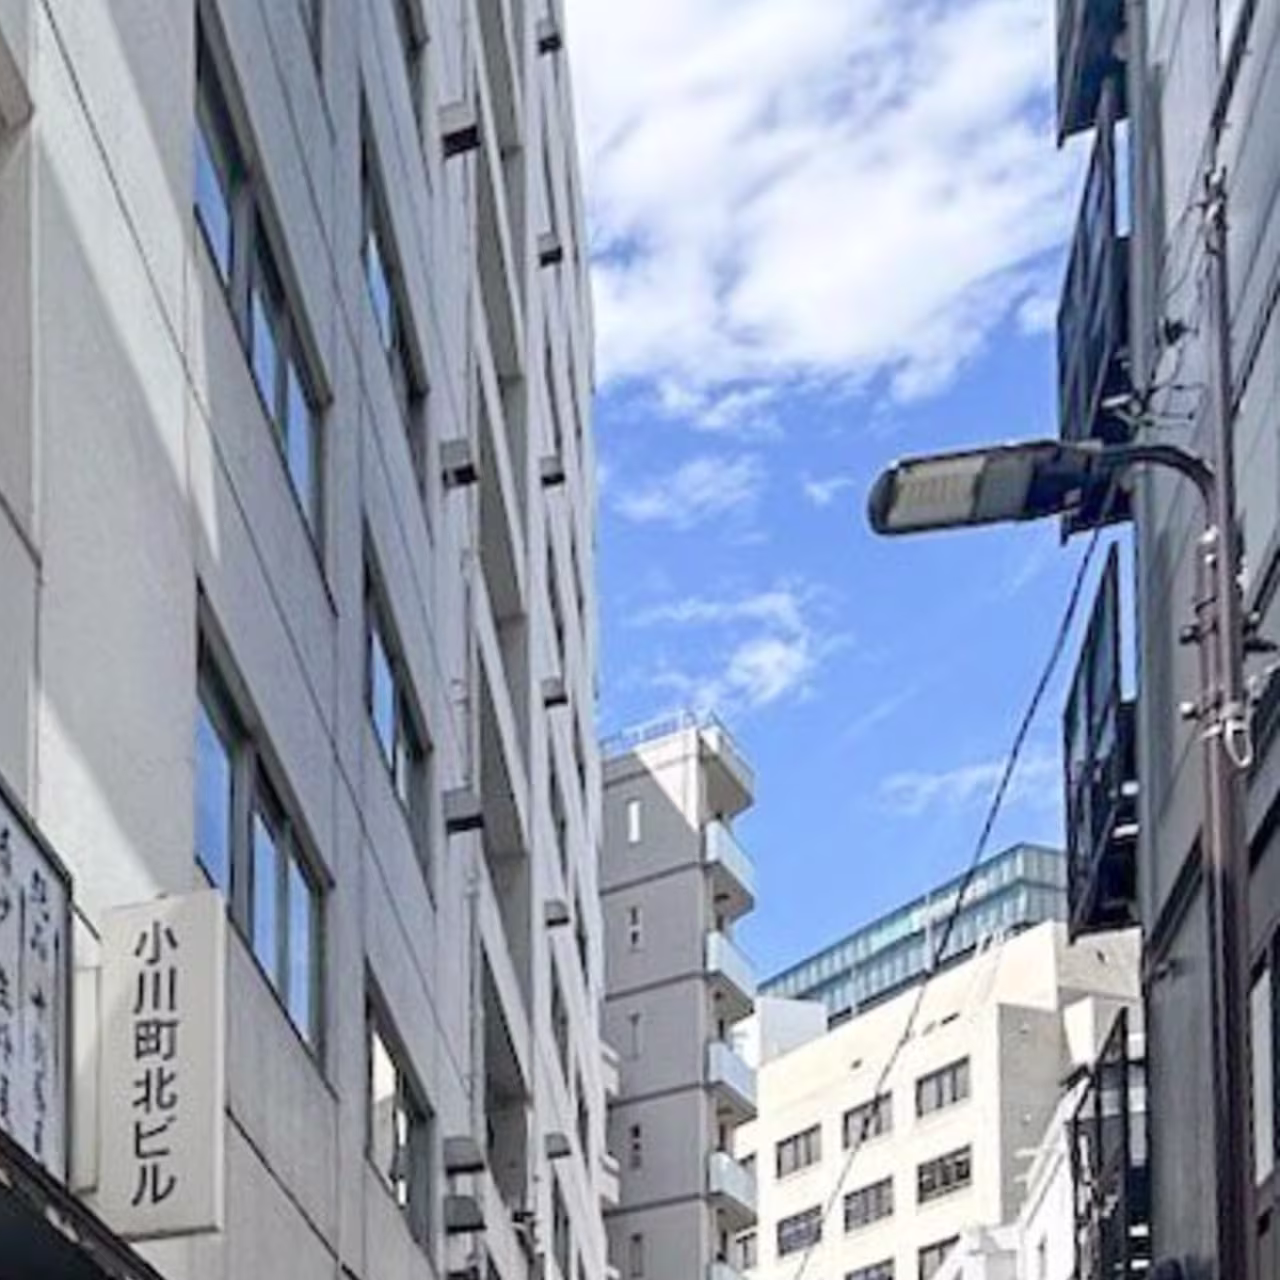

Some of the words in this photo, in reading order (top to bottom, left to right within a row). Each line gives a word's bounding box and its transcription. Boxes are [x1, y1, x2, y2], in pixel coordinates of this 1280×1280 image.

[132, 920, 179, 1206] 小川町北ビル
